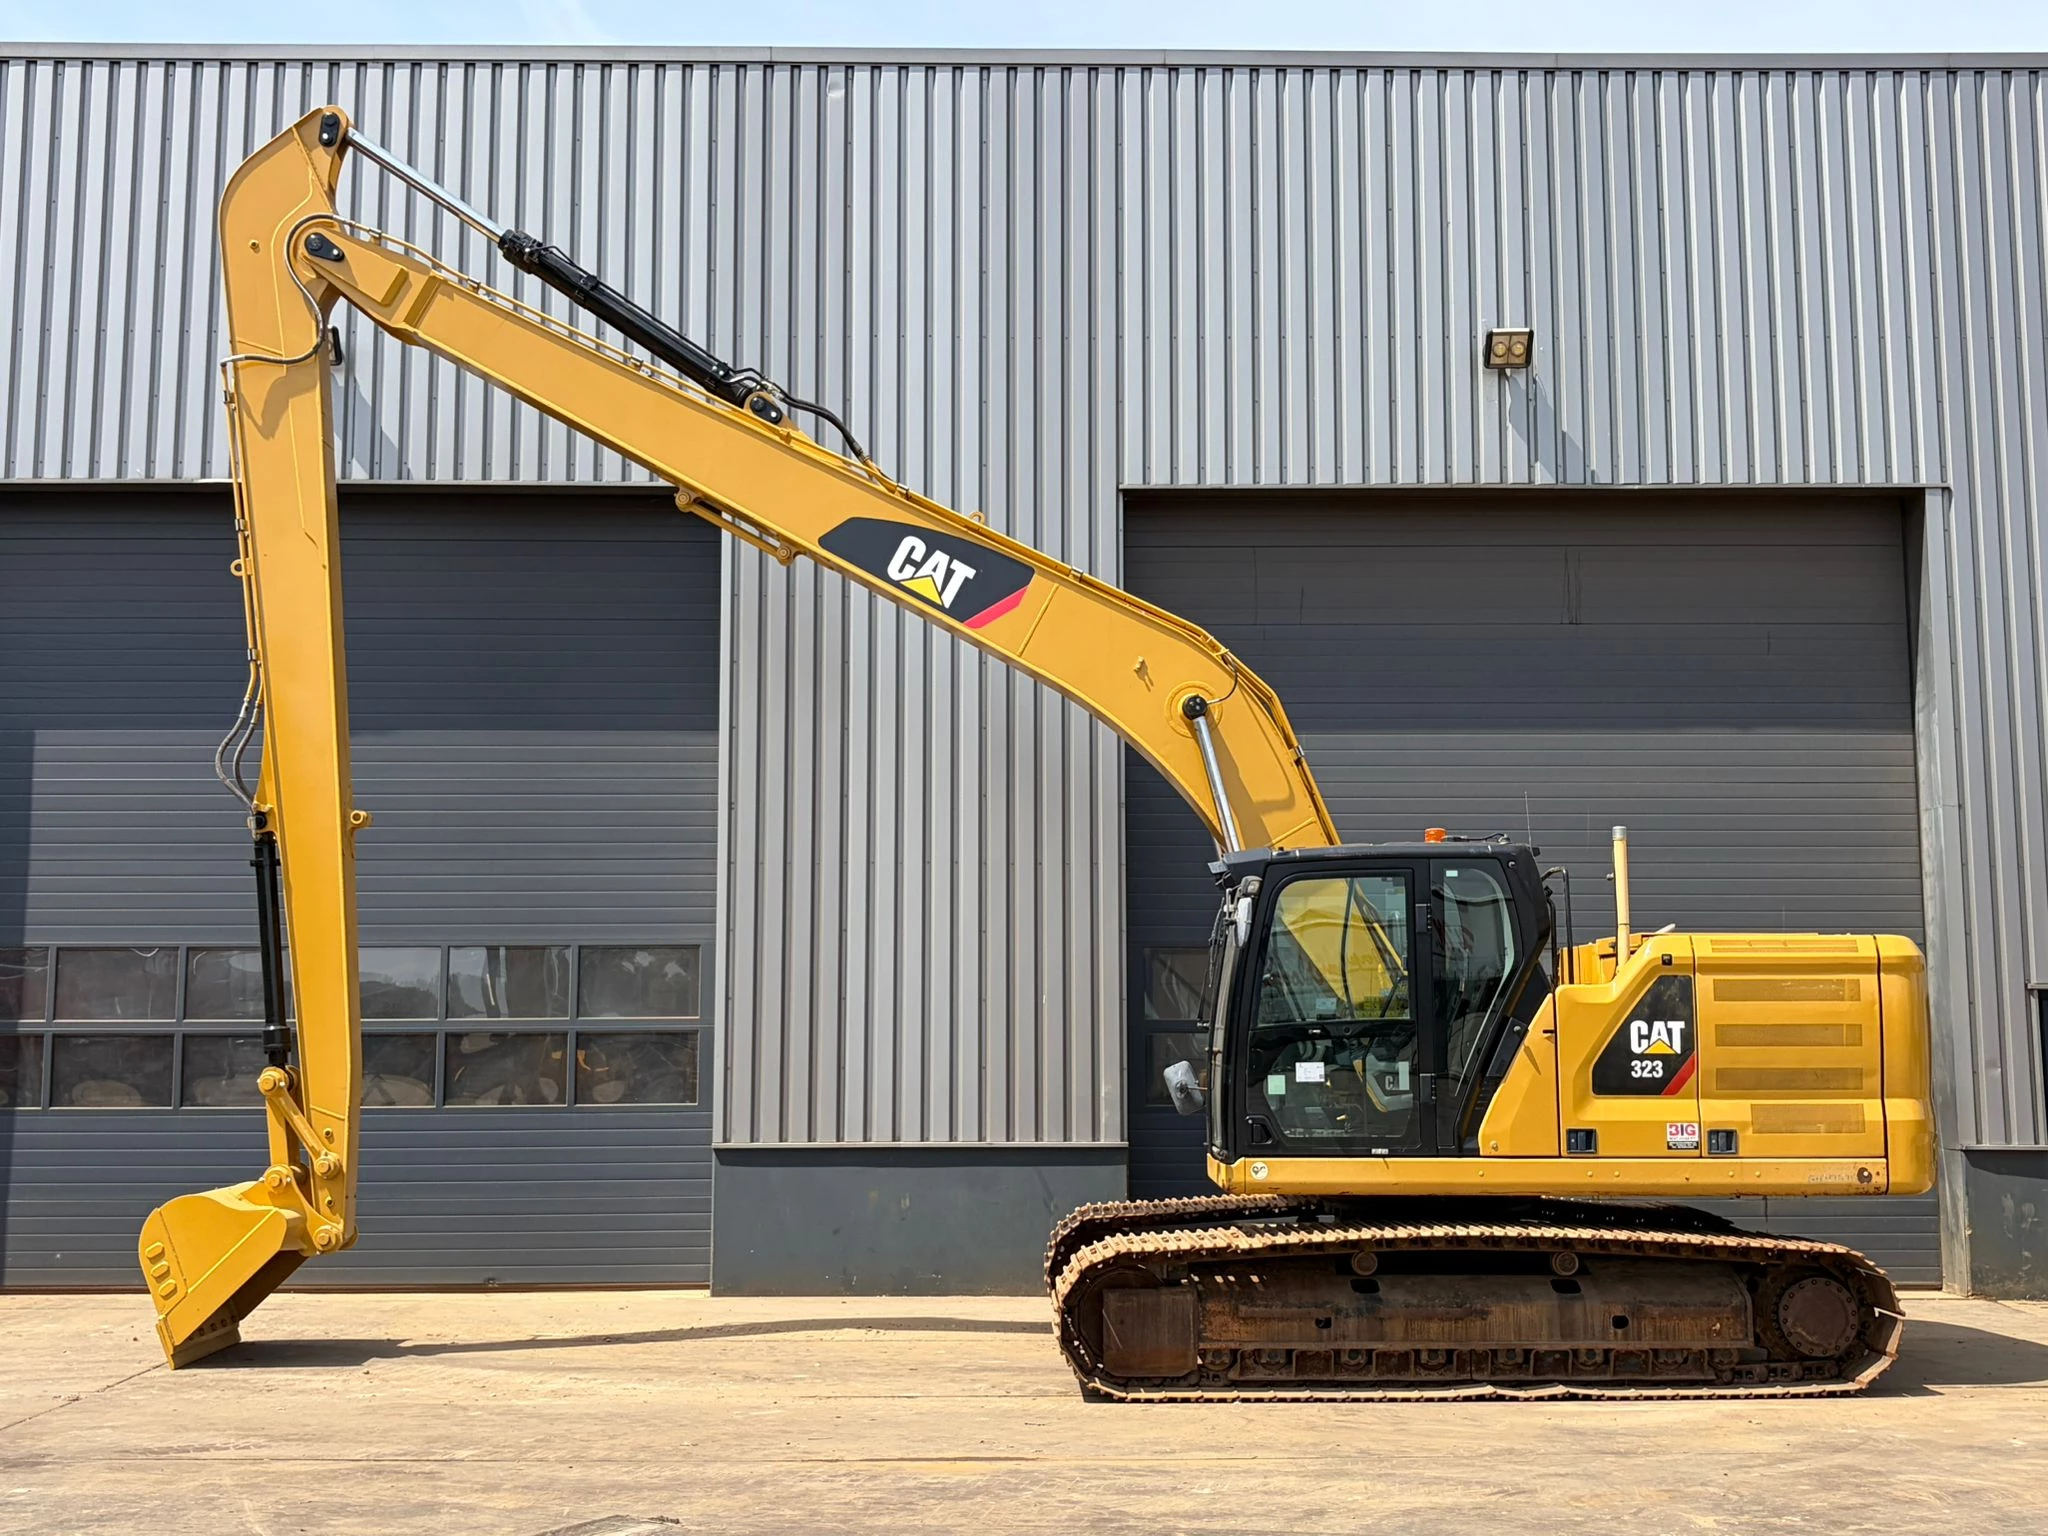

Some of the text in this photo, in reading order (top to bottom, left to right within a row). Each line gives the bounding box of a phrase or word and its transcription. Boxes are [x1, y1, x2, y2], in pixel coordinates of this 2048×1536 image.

[887, 536, 976, 609] CAT
[1630, 1020, 1685, 1055] CAT
[1631, 1060, 1663, 1078] 323
